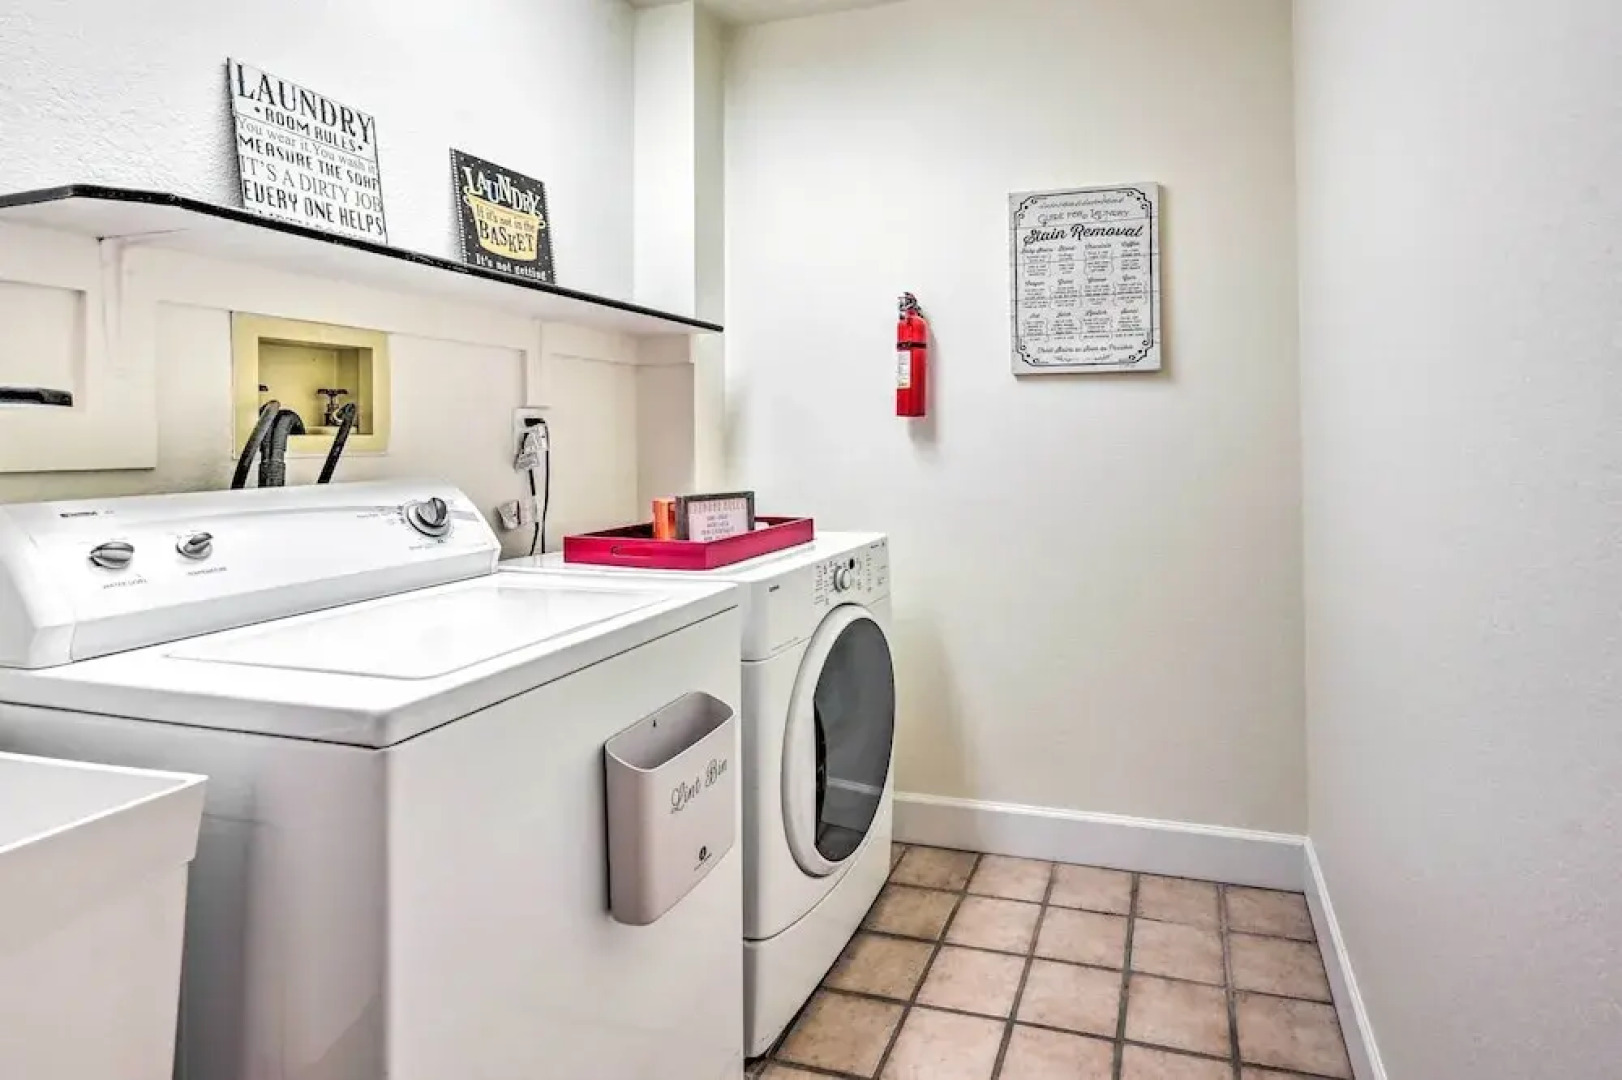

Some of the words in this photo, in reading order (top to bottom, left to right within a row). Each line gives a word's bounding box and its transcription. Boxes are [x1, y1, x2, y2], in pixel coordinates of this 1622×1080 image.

[237, 64, 373, 144] LAUNDRY
[239, 117, 263, 136] You
[267, 129, 297, 147] wear
[312, 144, 335, 161] You
[265, 107, 311, 136] ROOM
[315, 126, 356, 152] RULES
[239, 134, 314, 170] MEASURE
[318, 159, 344, 181] THE
[240, 155, 278, 182] IT'S
[283, 169, 296, 189] A
[300, 173, 350, 204] DIRTY
[355, 191, 383, 212] JOB
[462, 166, 541, 215] LAUNDRY
[304, 197, 335, 223] ONE
[338, 207, 384, 236] HELPS
[479, 219, 535, 253] BASKET
[1023, 228, 1067, 246] Stain
[1070, 223, 1144, 241] Removal
[705, 759, 727, 788] Bin
